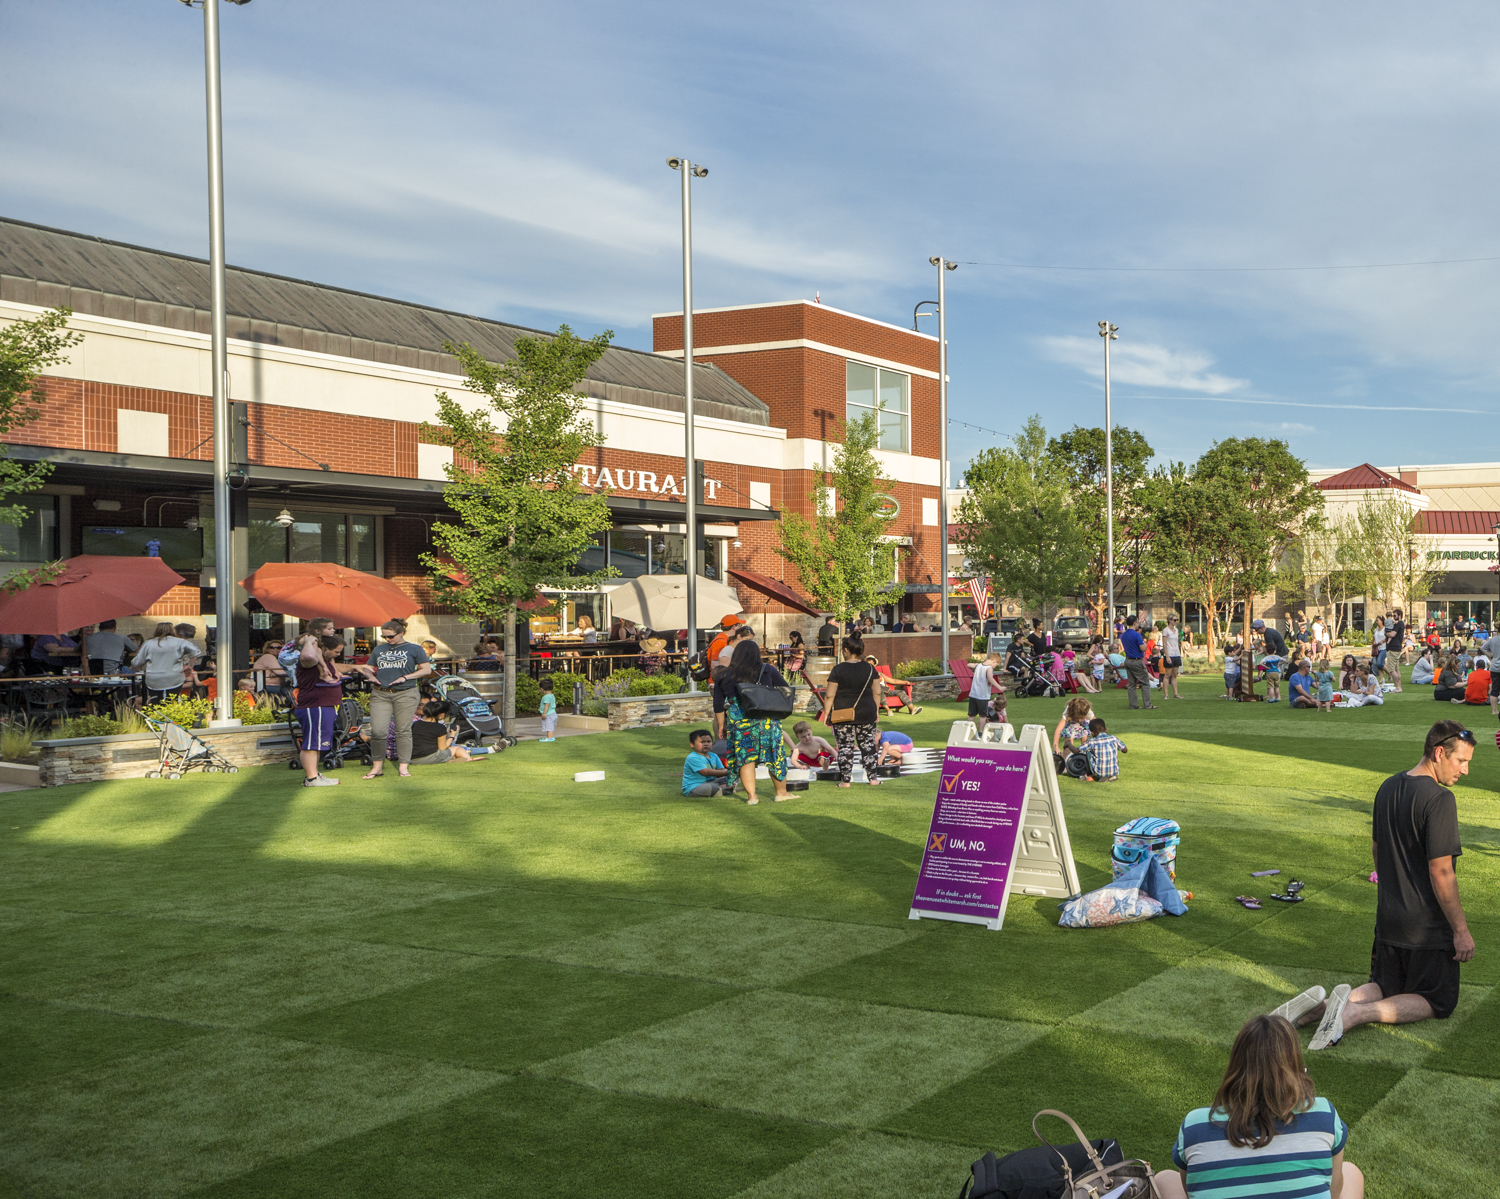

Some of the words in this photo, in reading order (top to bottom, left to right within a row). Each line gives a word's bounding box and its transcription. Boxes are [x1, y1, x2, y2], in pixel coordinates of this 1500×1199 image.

[961, 780, 981, 791] YES!
[950, 838, 967, 852] UM,
[968, 840, 986, 851] NO.
